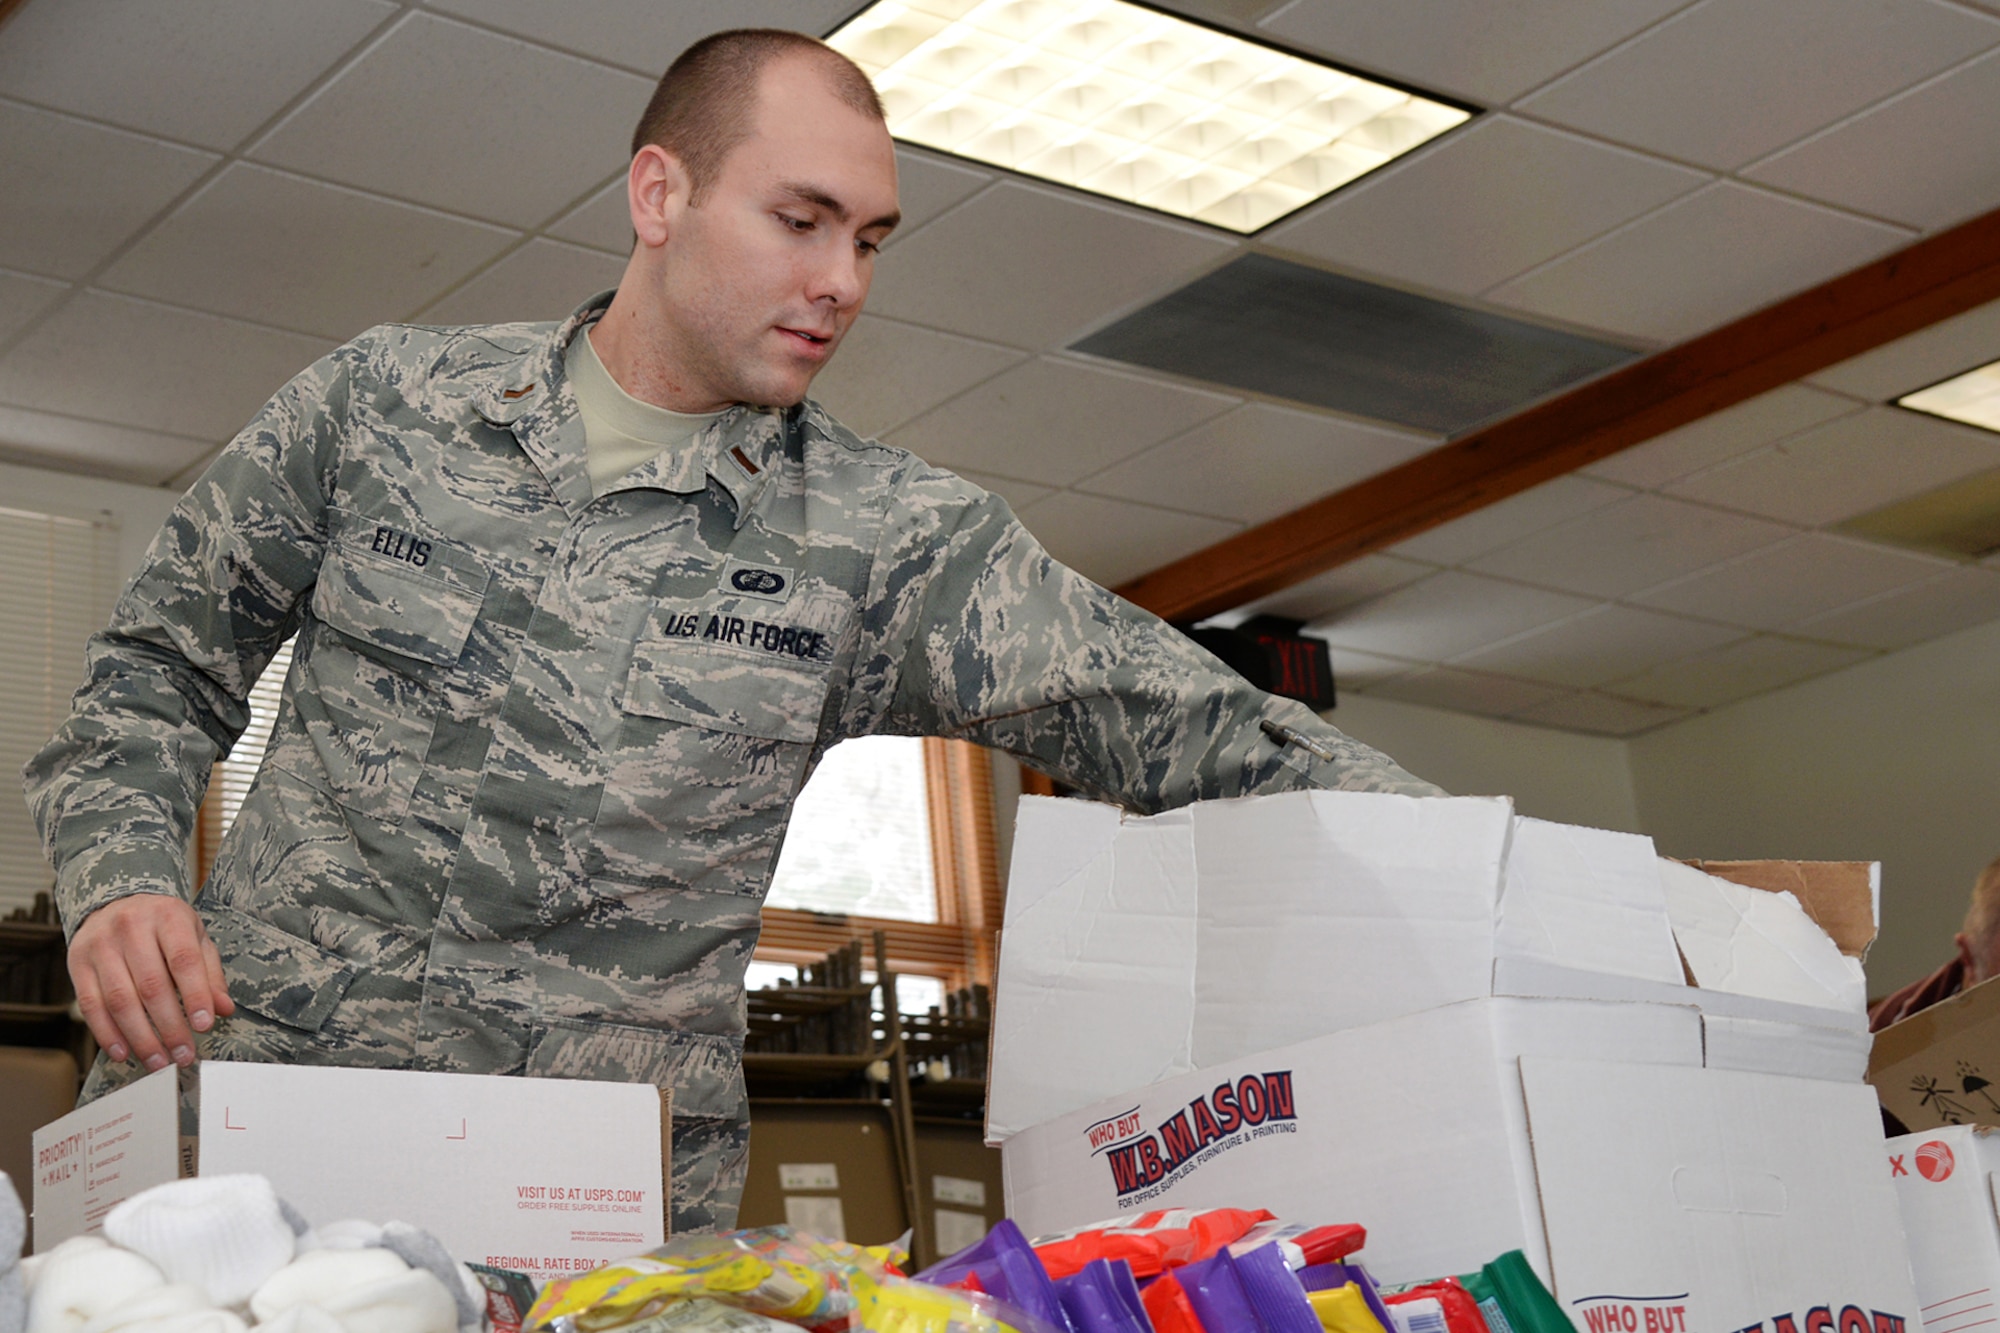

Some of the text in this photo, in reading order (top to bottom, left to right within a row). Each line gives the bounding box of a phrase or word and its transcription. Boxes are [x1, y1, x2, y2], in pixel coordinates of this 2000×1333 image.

[371, 527, 431, 566] ELLIS
[704, 615, 745, 644] AIR
[749, 621, 825, 658] FORCE
[1258, 635, 1318, 699] XIT
[1088, 1113, 1142, 1149] WHO BUT
[49, 1163, 71, 1186] MAIL
[182, 1144, 194, 1178] Than
[1118, 1122, 1297, 1210] FOR OFFICE SUPPLIES, FURNITURE & PRINTING
[517, 1186, 546, 1199] VISIT
[550, 1187, 564, 1200] US
[568, 1188, 582, 1201] AT
[517, 1202, 642, 1213] ORDER FREE SUPPLIES ONLINE
[486, 1256, 541, 1270] REGIONAL
[544, 1257, 570, 1270] RATE
[574, 1259, 595, 1271] BOX
[1583, 1304, 1687, 1333] WHO BUT
